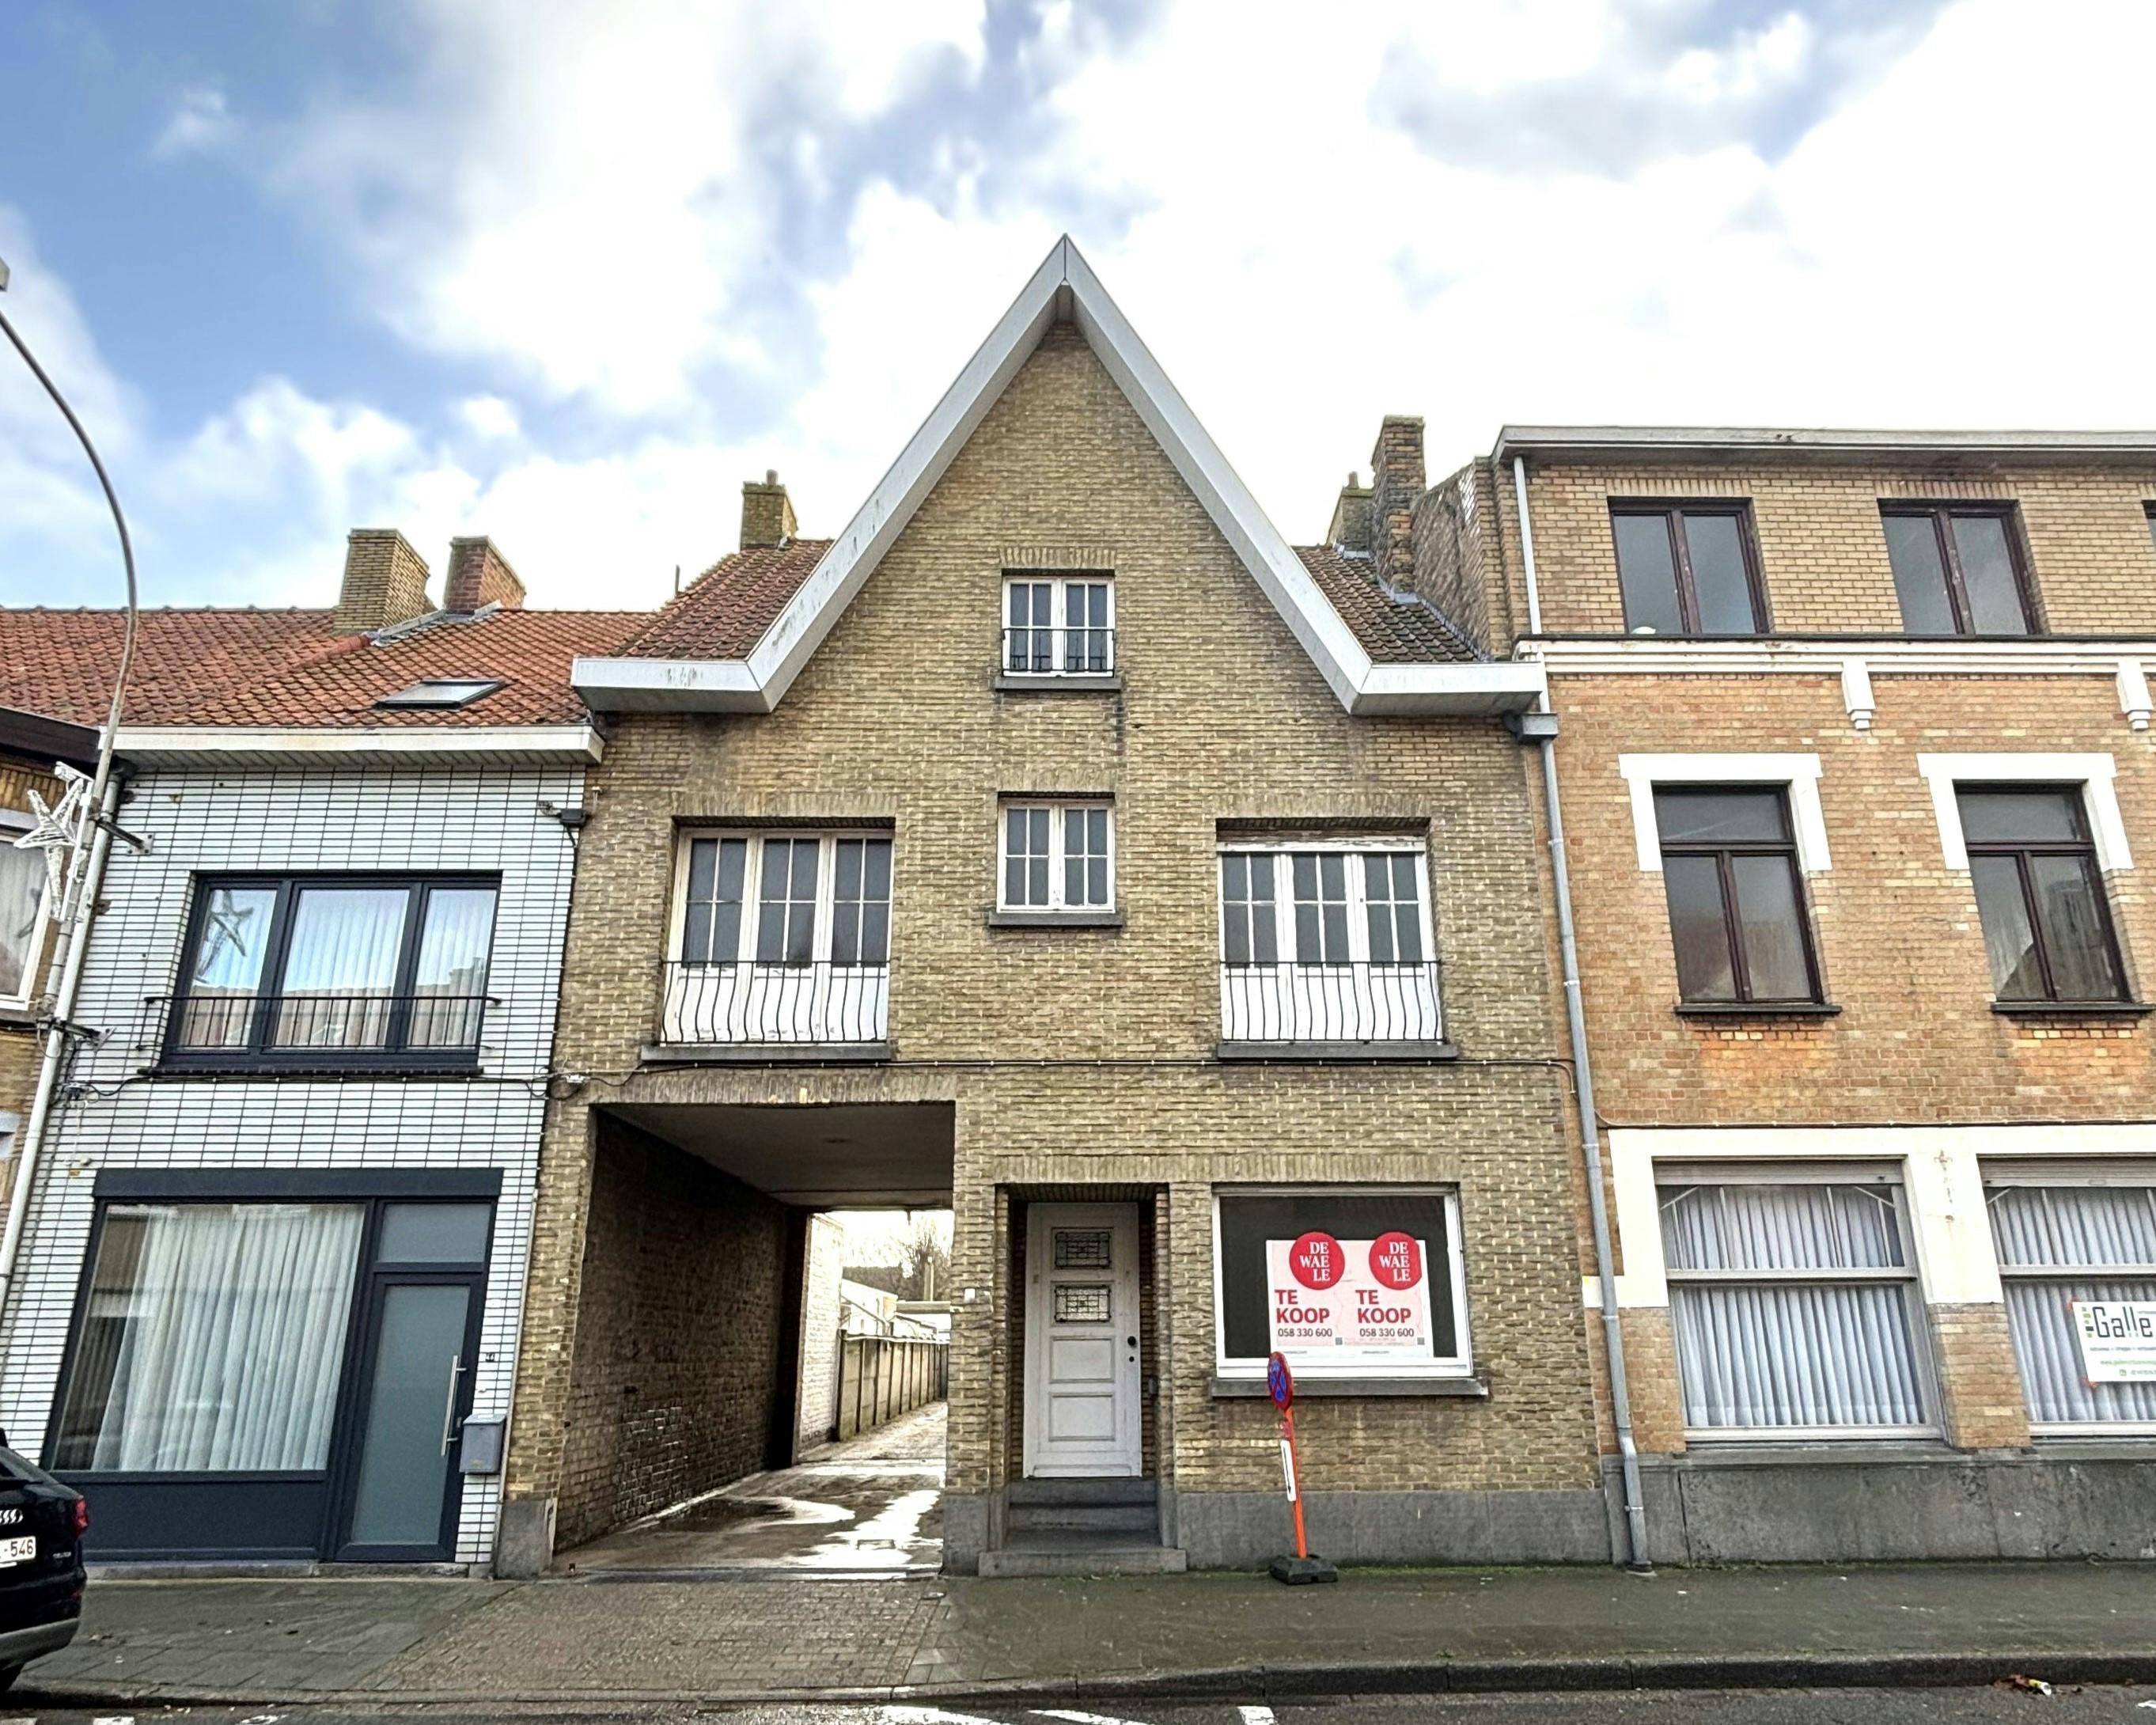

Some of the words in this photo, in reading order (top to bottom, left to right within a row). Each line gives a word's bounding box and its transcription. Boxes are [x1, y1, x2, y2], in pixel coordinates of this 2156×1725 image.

[1309, 1242, 1329, 1254] DE
[1389, 1242, 1409, 1254] DE
[1299, 1255, 1330, 1268] WAE
[1379, 1255, 1410, 1268] WAE
[1313, 1268, 1331, 1281] LE
[1393, 1268, 1411, 1281] LE
[1275, 1290, 1298, 1305] TE
[1355, 1290, 1379, 1305] TE
[1276, 1308, 1330, 1324] KOOP
[1357, 1308, 1411, 1324] KOOP
[2092, 1306, 2153, 1337] Galle
[1278, 1328, 1295, 1337] 058
[1297, 1328, 1314, 1337] 330
[1315, 1328, 1332, 1337] 600
[1359, 1328, 1377, 1337] 058
[1378, 1328, 1396, 1337] 330
[1397, 1328, 1415, 1337] 600
[0, 1539, 33, 1559] -546
